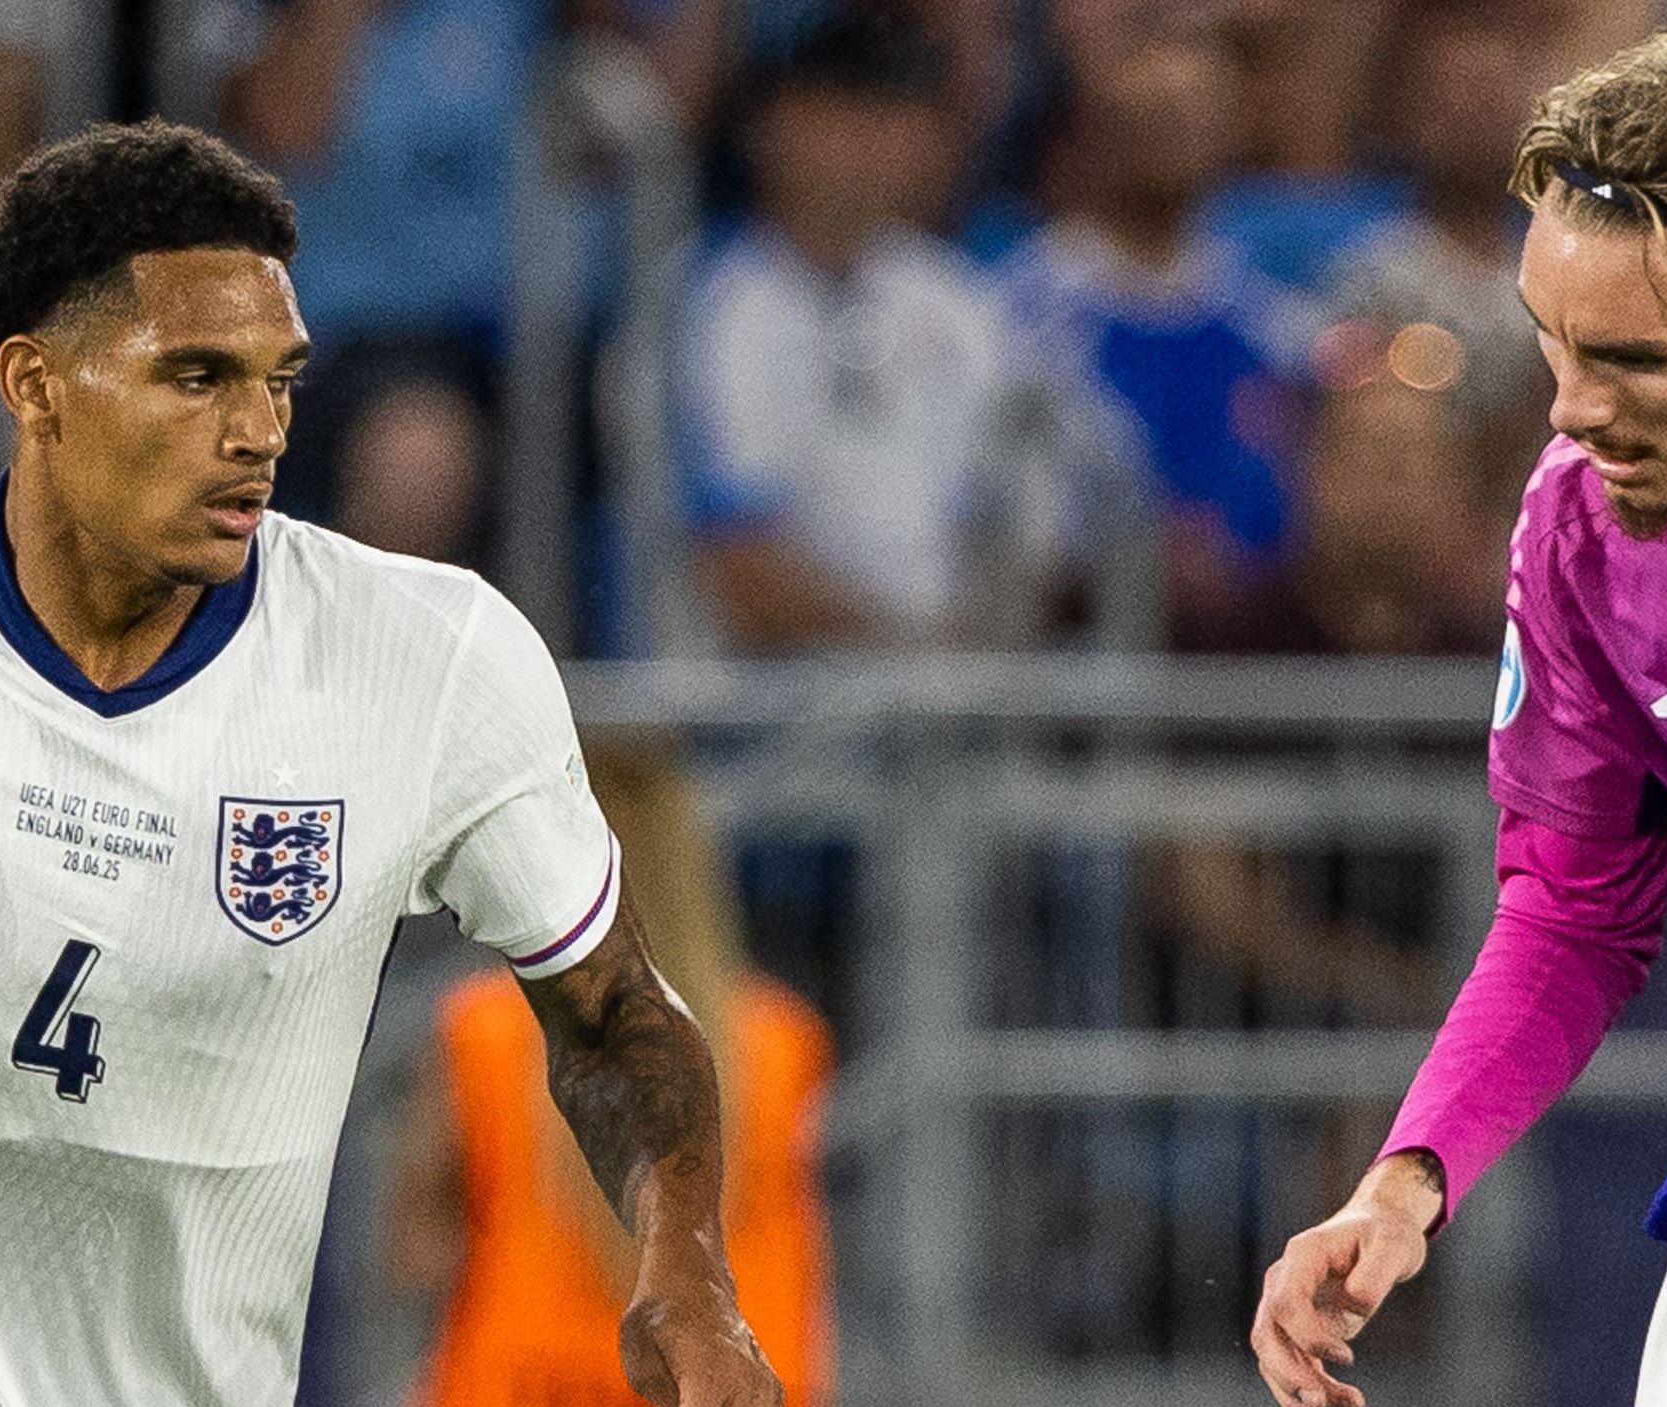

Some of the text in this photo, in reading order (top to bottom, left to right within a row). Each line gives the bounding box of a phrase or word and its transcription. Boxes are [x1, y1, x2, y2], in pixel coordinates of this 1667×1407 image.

[16, 809, 175, 866] ENGLAND v GERMANY
[19, 782, 177, 838] UEFA U21 EURO FINAL
[62, 850, 121, 881] 28.06.25
[12, 938, 106, 1104] 4
